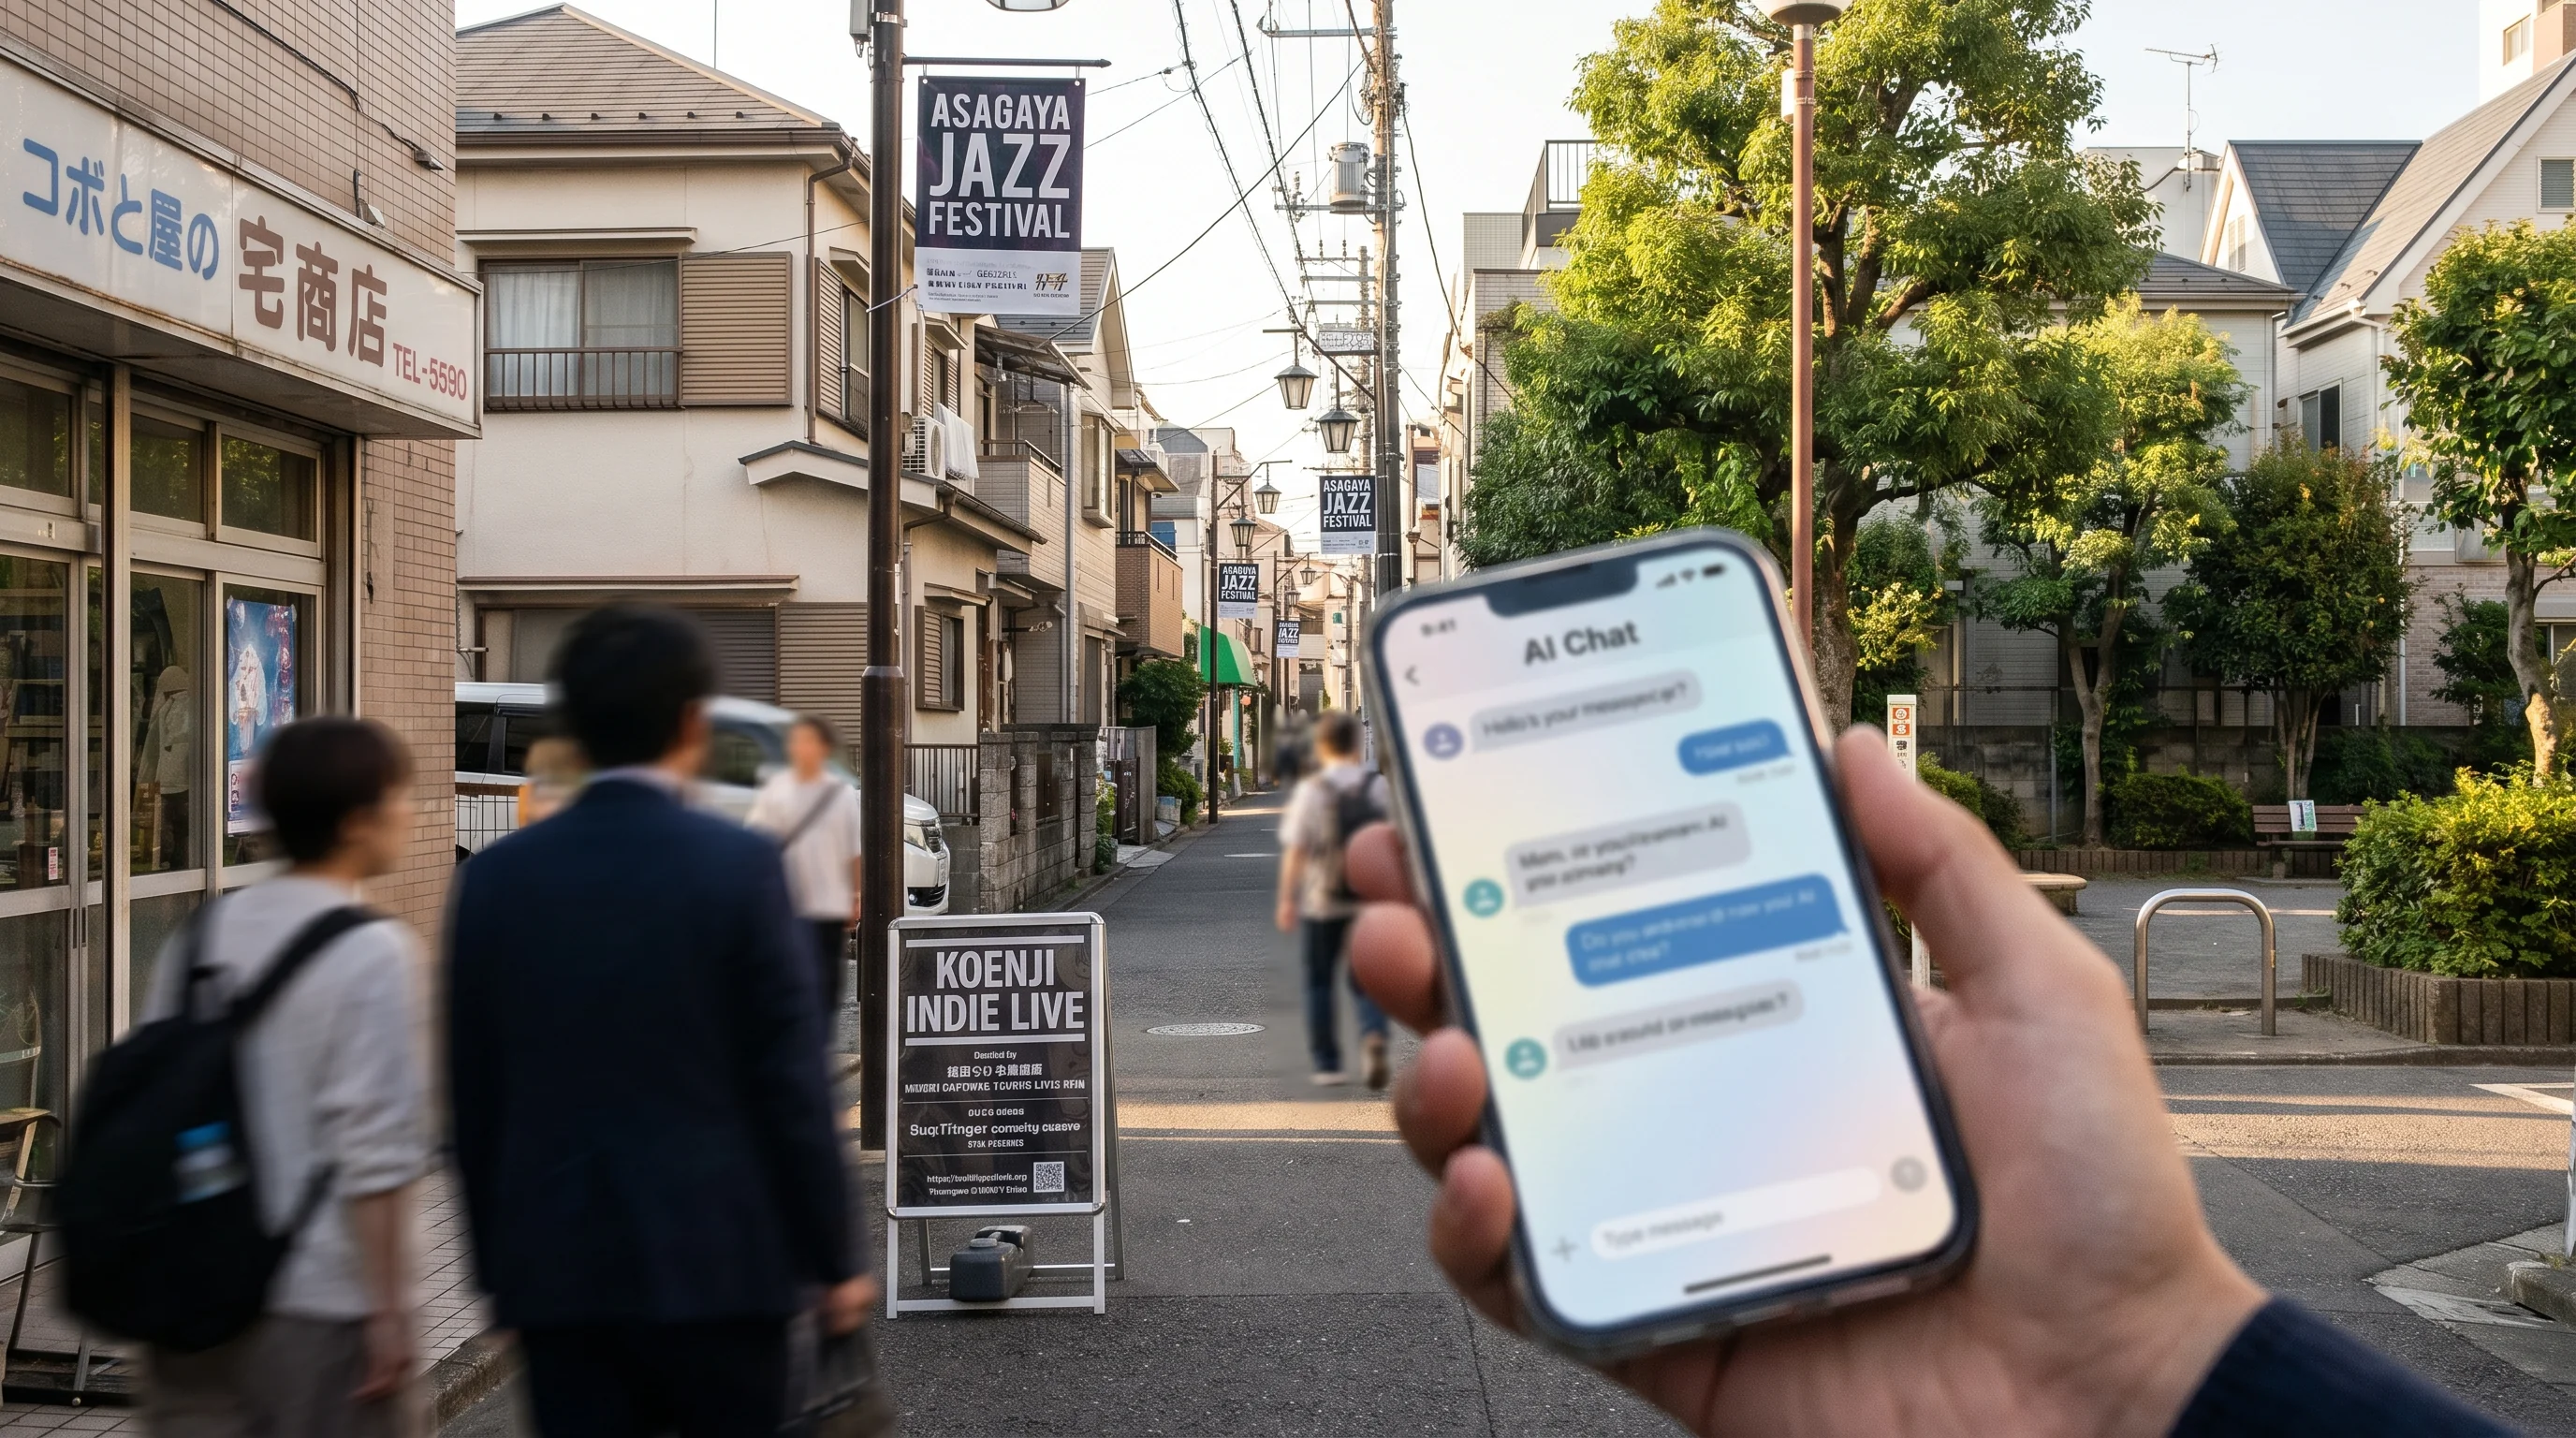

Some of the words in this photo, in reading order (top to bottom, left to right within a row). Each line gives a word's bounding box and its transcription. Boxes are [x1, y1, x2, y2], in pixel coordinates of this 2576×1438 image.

[930, 93, 1070, 130] ASAGAYA
[929, 132, 1071, 199] JAZZ
[929, 201, 1070, 239] FESTIVAL
[23, 137, 220, 281] コボと屋の
[238, 214, 388, 368] 宅商店
[393, 343, 467, 402] TEL-5590
[1323, 479, 1371, 492] ASAGAYA
[1323, 492, 1371, 515] JAZZ
[1323, 514, 1372, 528] FESTIVAL
[1221, 575, 1257, 591] JAZZ
[1524, 635, 1558, 666] AI
[1563, 621, 1641, 657] Chat
[936, 948, 1055, 990] KOENJI
[907, 992, 1000, 1034] INDIE
[1011, 990, 1085, 1031] LIVE
